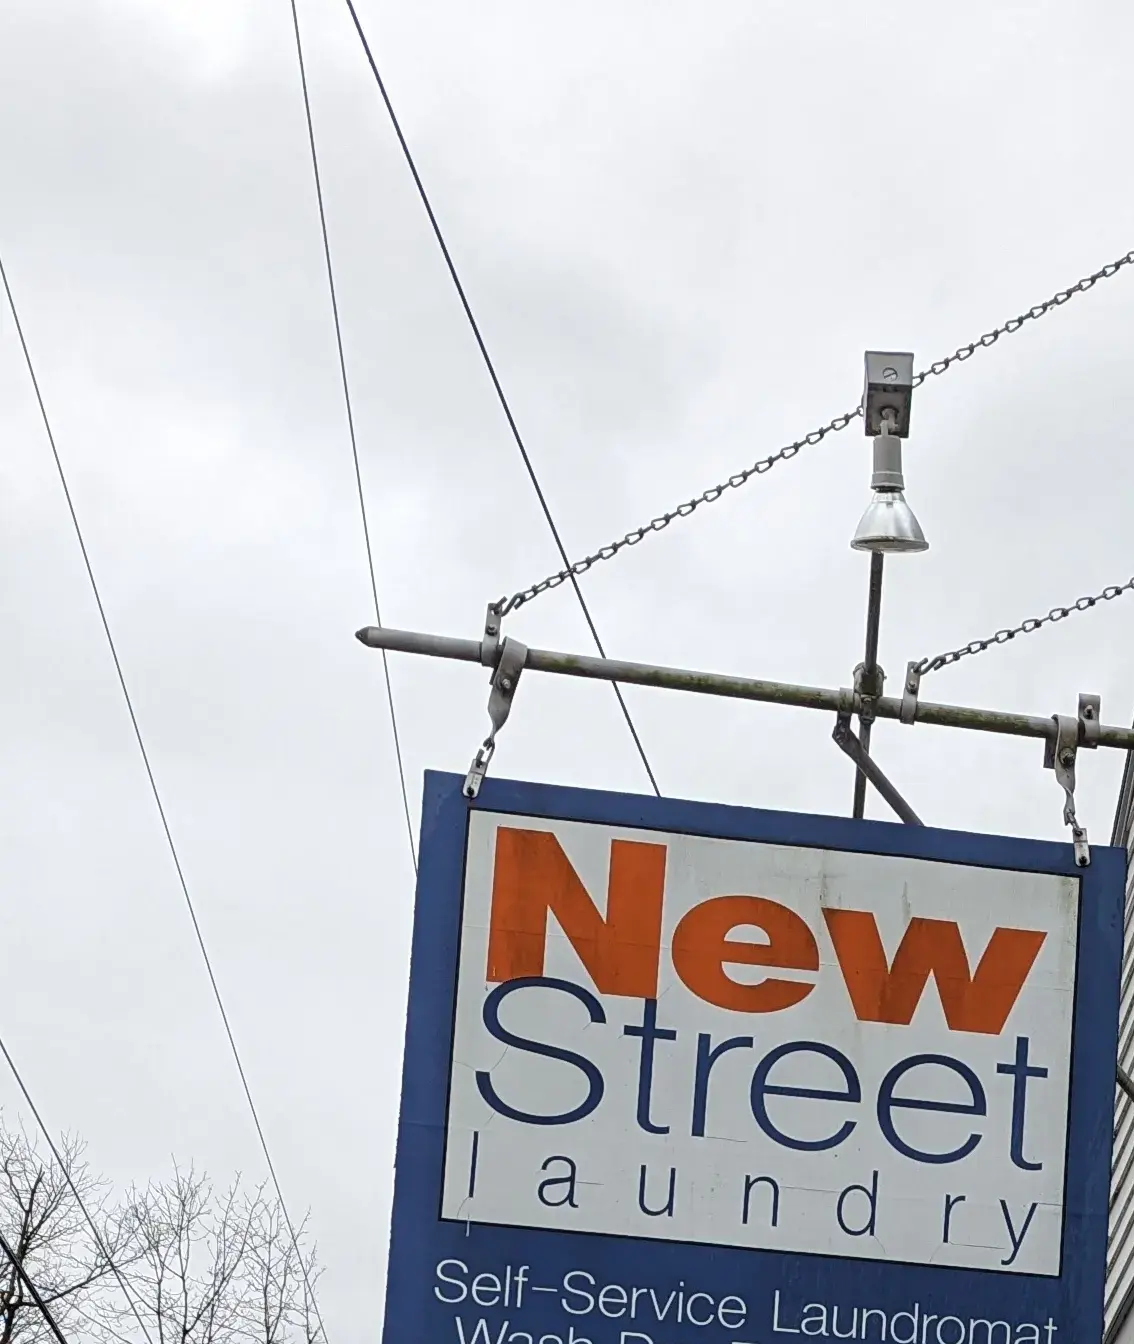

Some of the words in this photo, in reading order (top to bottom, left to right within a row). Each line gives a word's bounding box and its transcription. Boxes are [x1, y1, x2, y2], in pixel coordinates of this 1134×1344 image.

[486, 825, 1048, 1035] New
[475, 976, 1049, 1172] Street
[467, 1130, 1038, 1265] laundry
[433, 1258, 747, 1330] Self-Service
